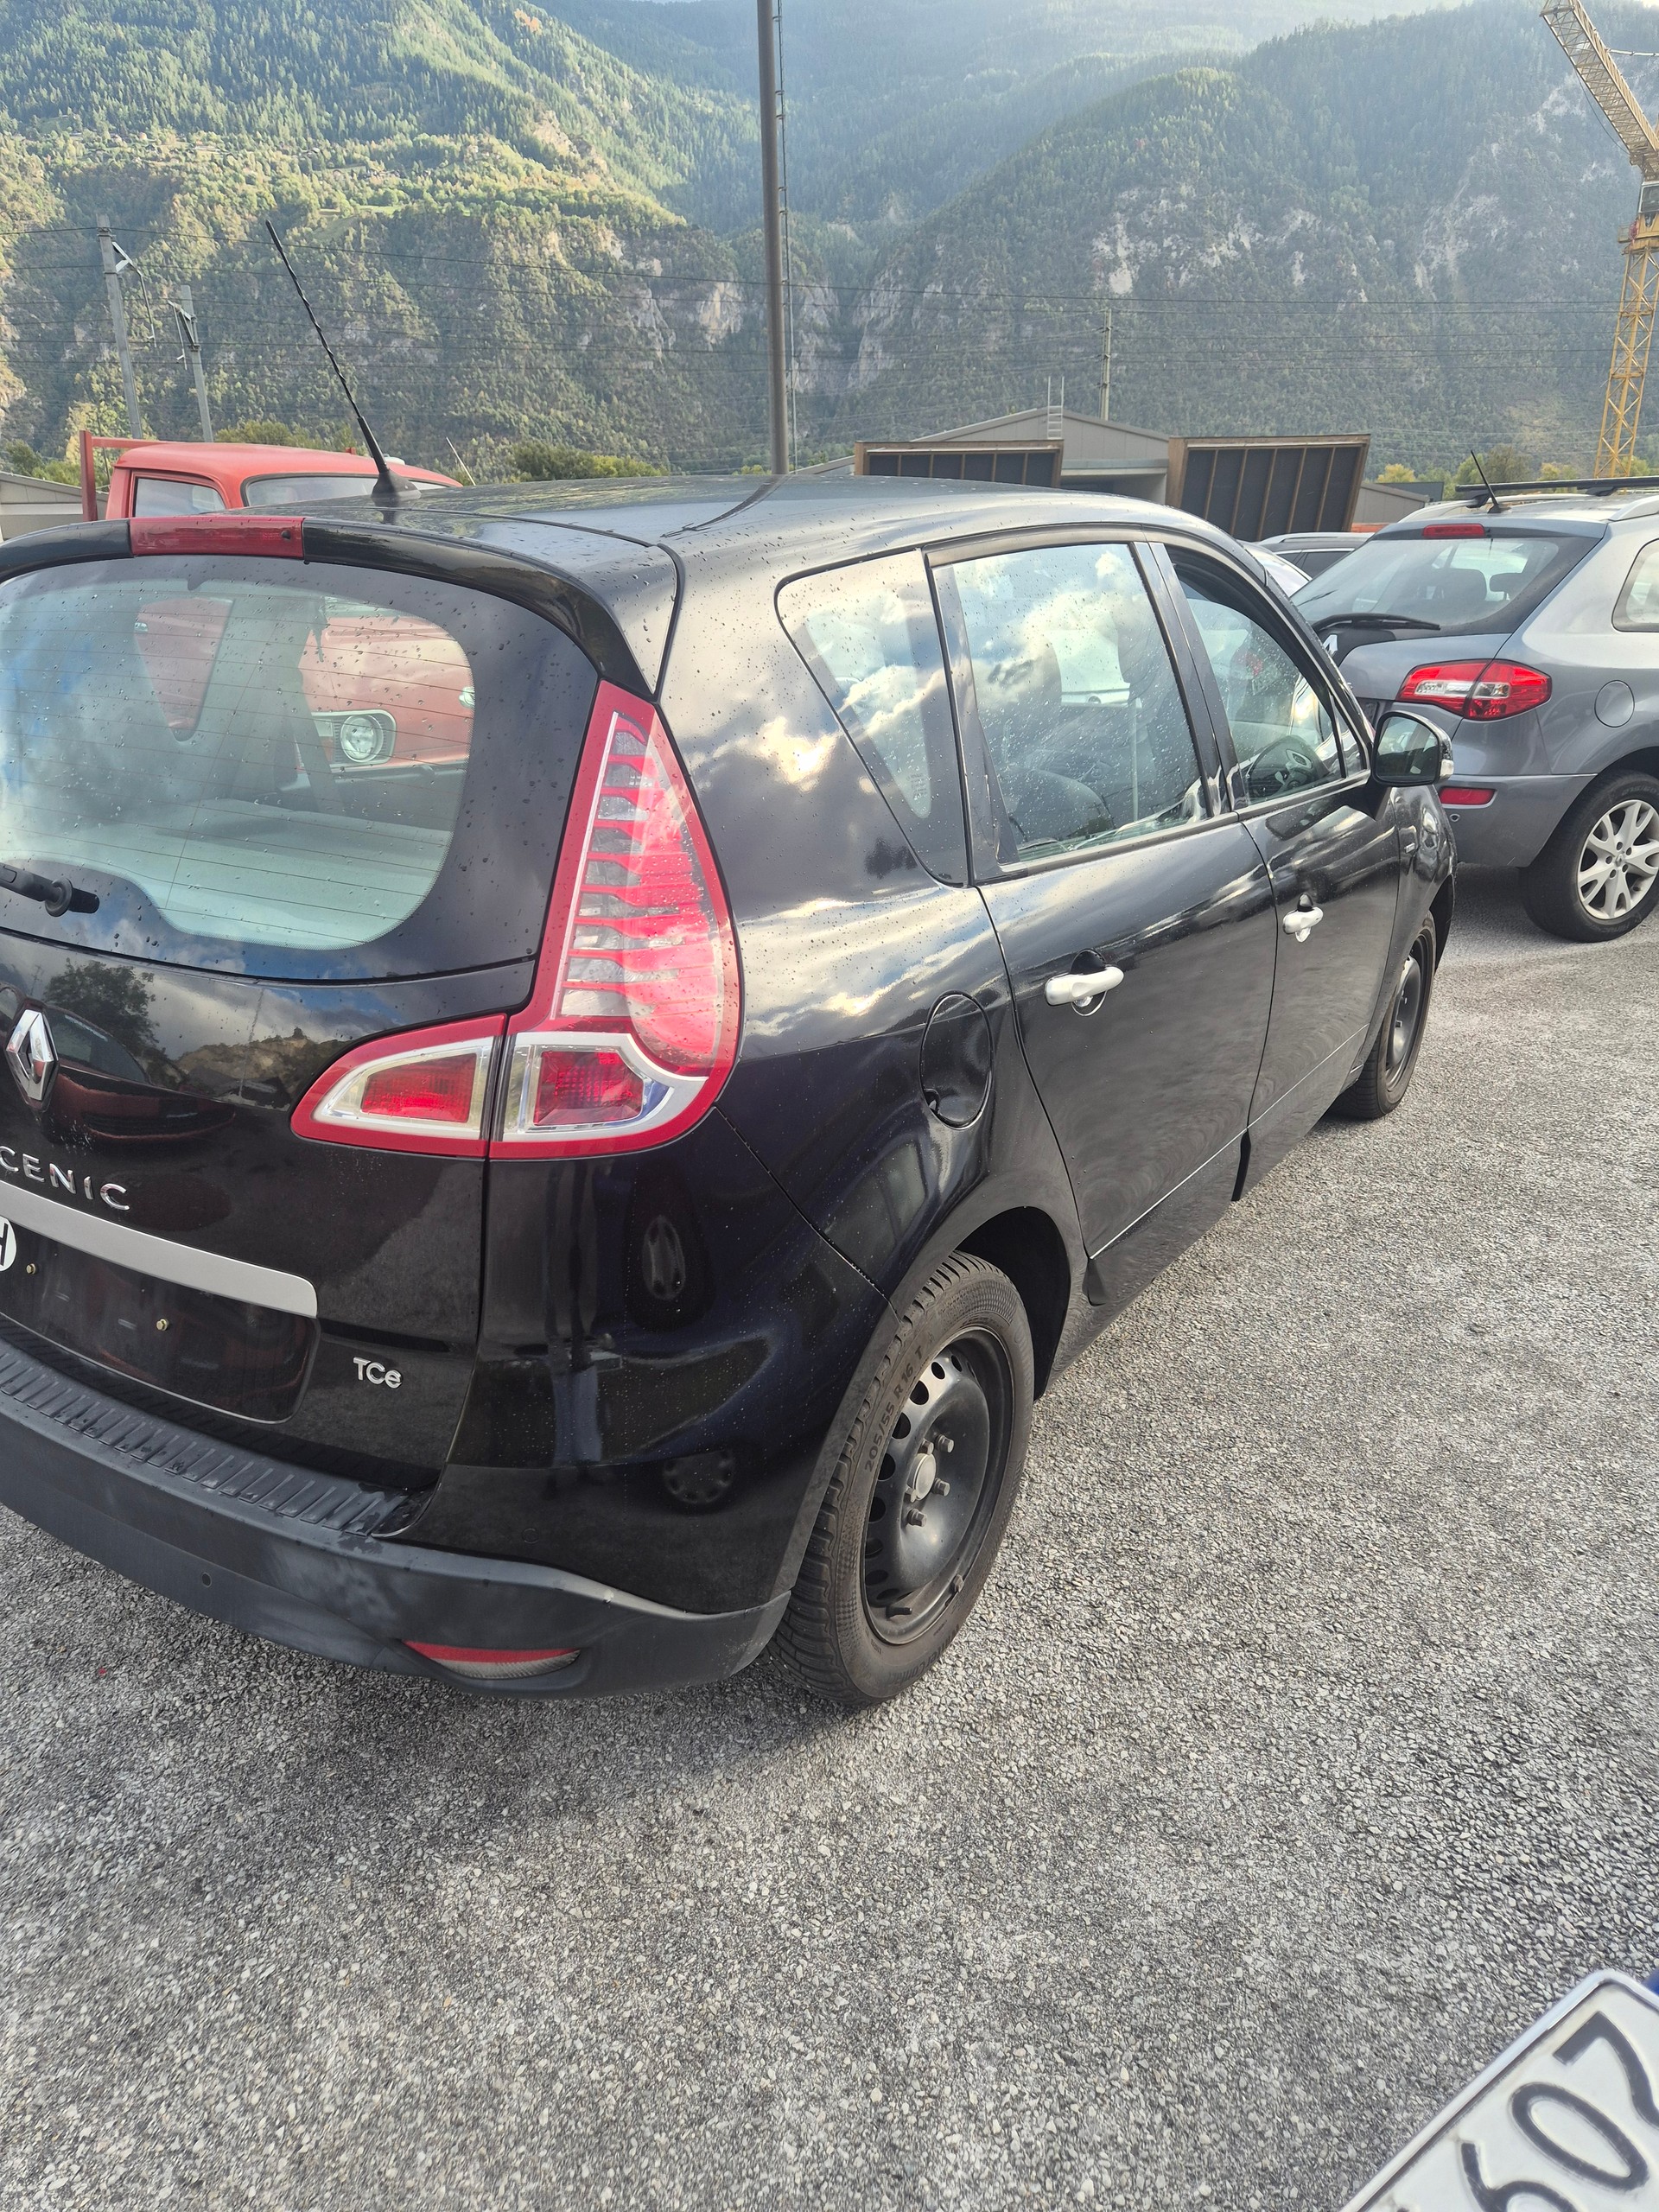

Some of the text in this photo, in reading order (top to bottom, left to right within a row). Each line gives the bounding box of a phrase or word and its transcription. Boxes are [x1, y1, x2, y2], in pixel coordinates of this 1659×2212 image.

[0, 1145, 130, 1211] CENIC
[353, 1357, 403, 1389] TCe
[865, 1402, 895, 1472] 205/55
